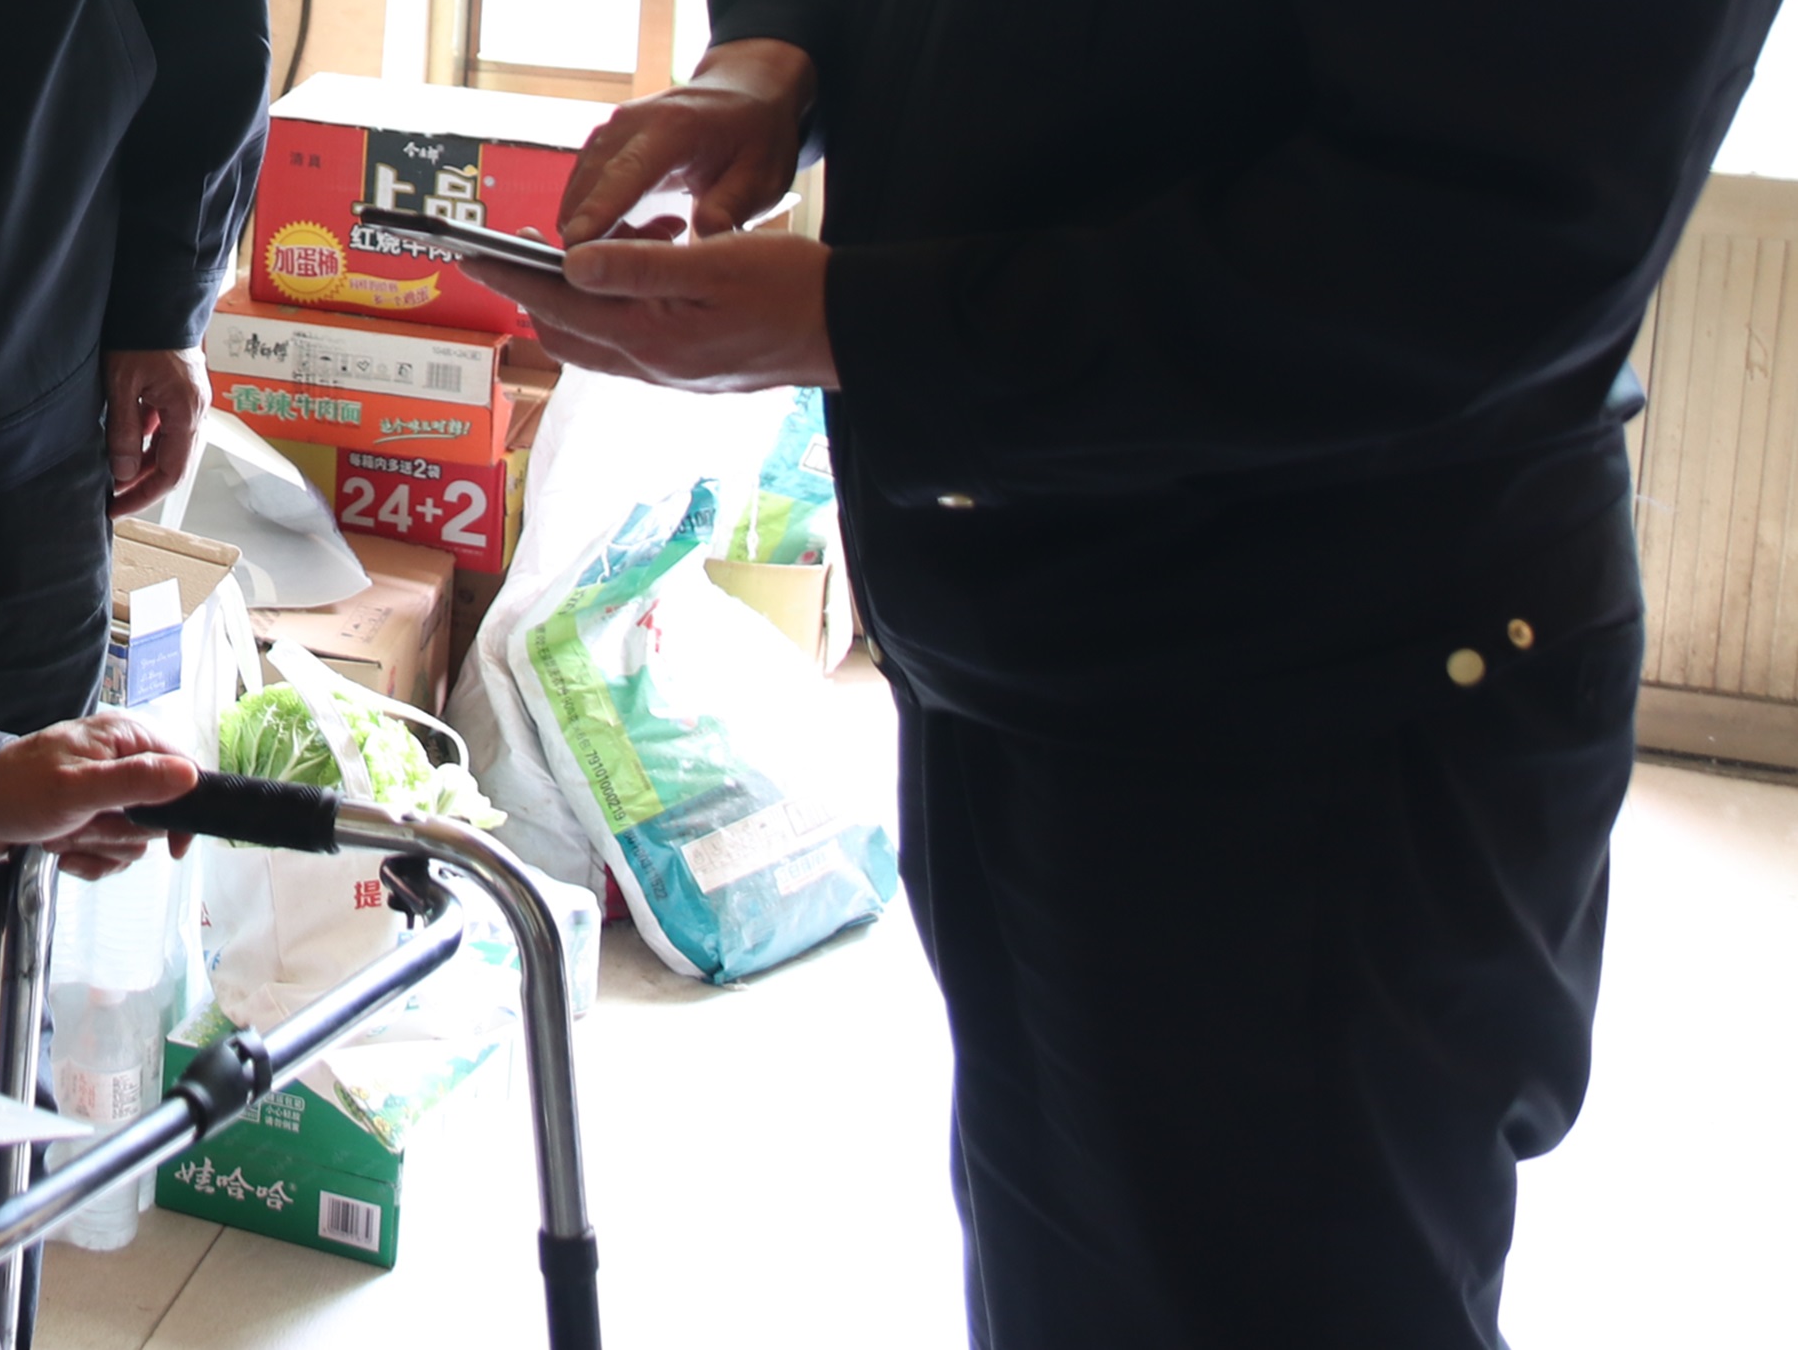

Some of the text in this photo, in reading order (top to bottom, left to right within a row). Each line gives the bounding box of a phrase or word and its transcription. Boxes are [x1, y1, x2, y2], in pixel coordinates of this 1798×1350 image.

[352, 162, 486, 228] 上品
[273, 246, 340, 277] 加蛋桶
[244, 333, 289, 362] 康师傅
[223, 384, 362, 426] 香辣牛肉面
[349, 453, 442, 480] 每箱内多送2袋
[341, 476, 488, 548] 24+2
[354, 879, 382, 910] 提
[174, 1157, 294, 1211] 娃哈哈
